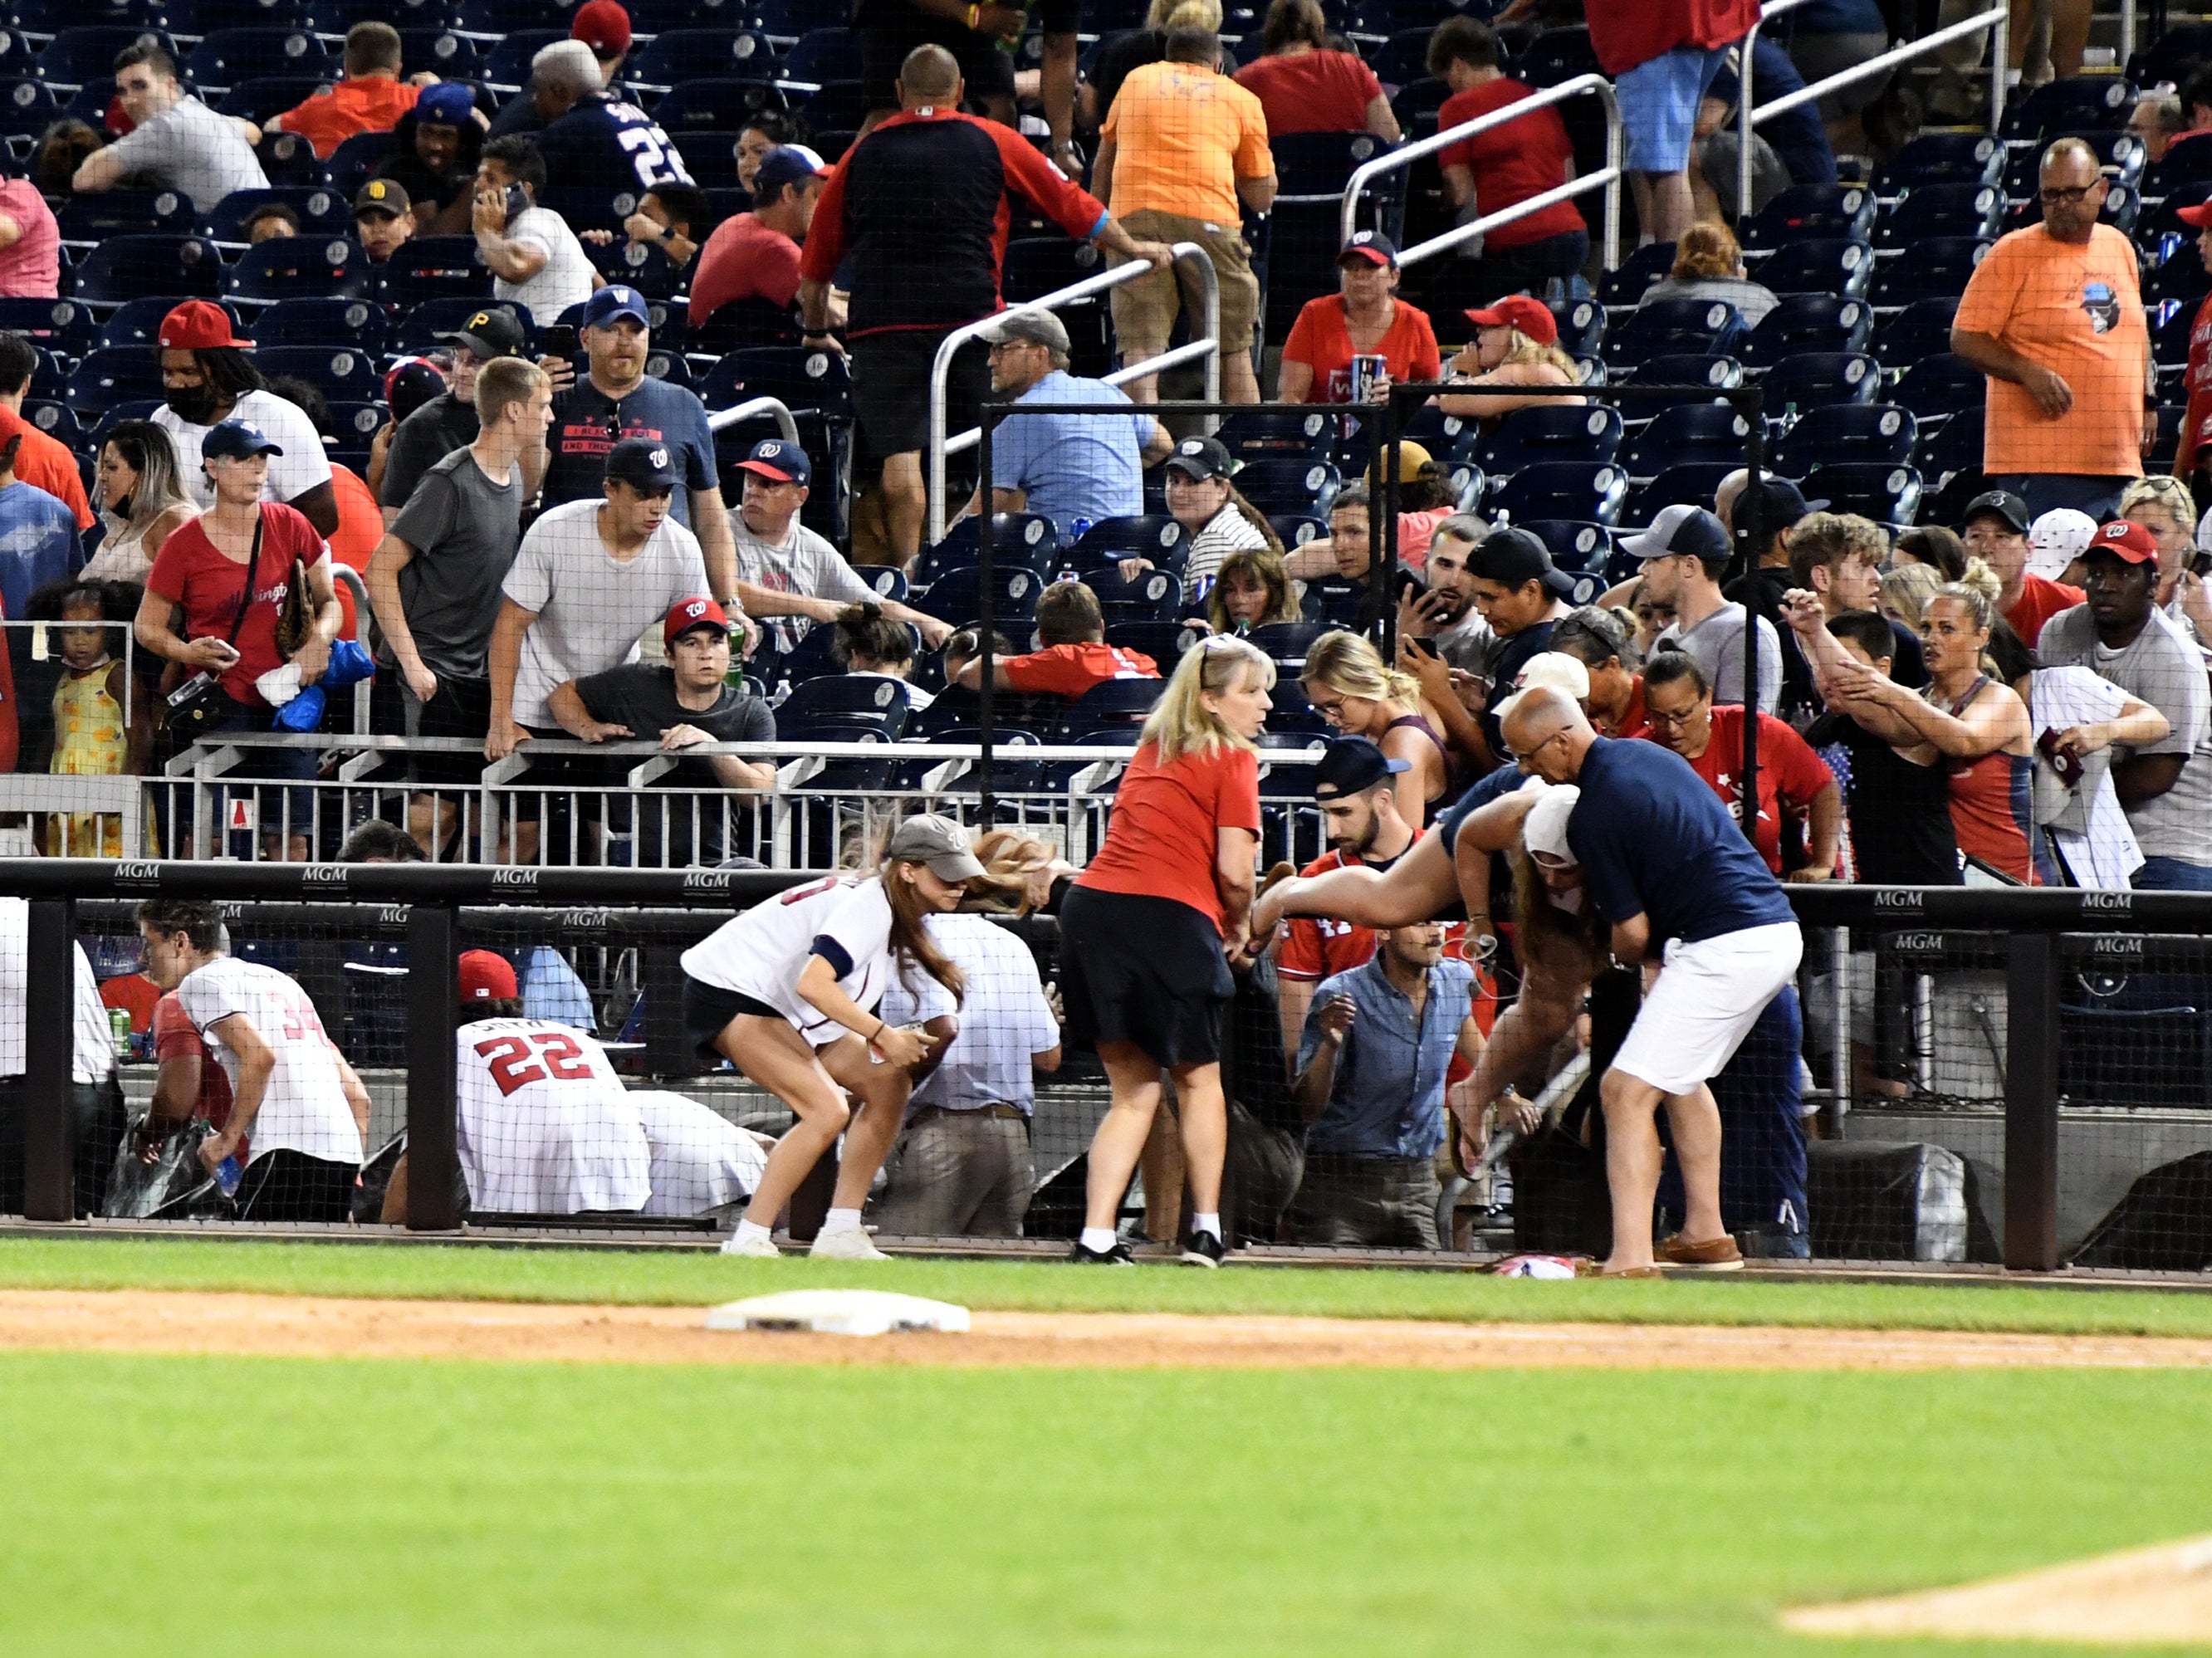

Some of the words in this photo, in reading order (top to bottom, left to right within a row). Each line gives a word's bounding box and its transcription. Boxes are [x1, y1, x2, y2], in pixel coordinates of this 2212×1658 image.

[469, 311, 489, 330] P
[758, 443, 782, 458] W
[649, 448, 668, 469] W
[2106, 523, 2129, 539] W
[686, 600, 707, 618] W
[115, 863, 160, 878] MGM
[302, 866, 349, 881] MGM
[492, 869, 539, 884] MGM
[683, 873, 731, 888] MGM
[1874, 891, 1924, 907] MGM
[2082, 893, 2133, 909] MGM
[379, 908, 409, 923] MG
[563, 912, 608, 927] MGM
[1896, 933, 1944, 950] MGM
[2094, 938, 2143, 953] MGM
[473, 1033, 596, 1098] 22
